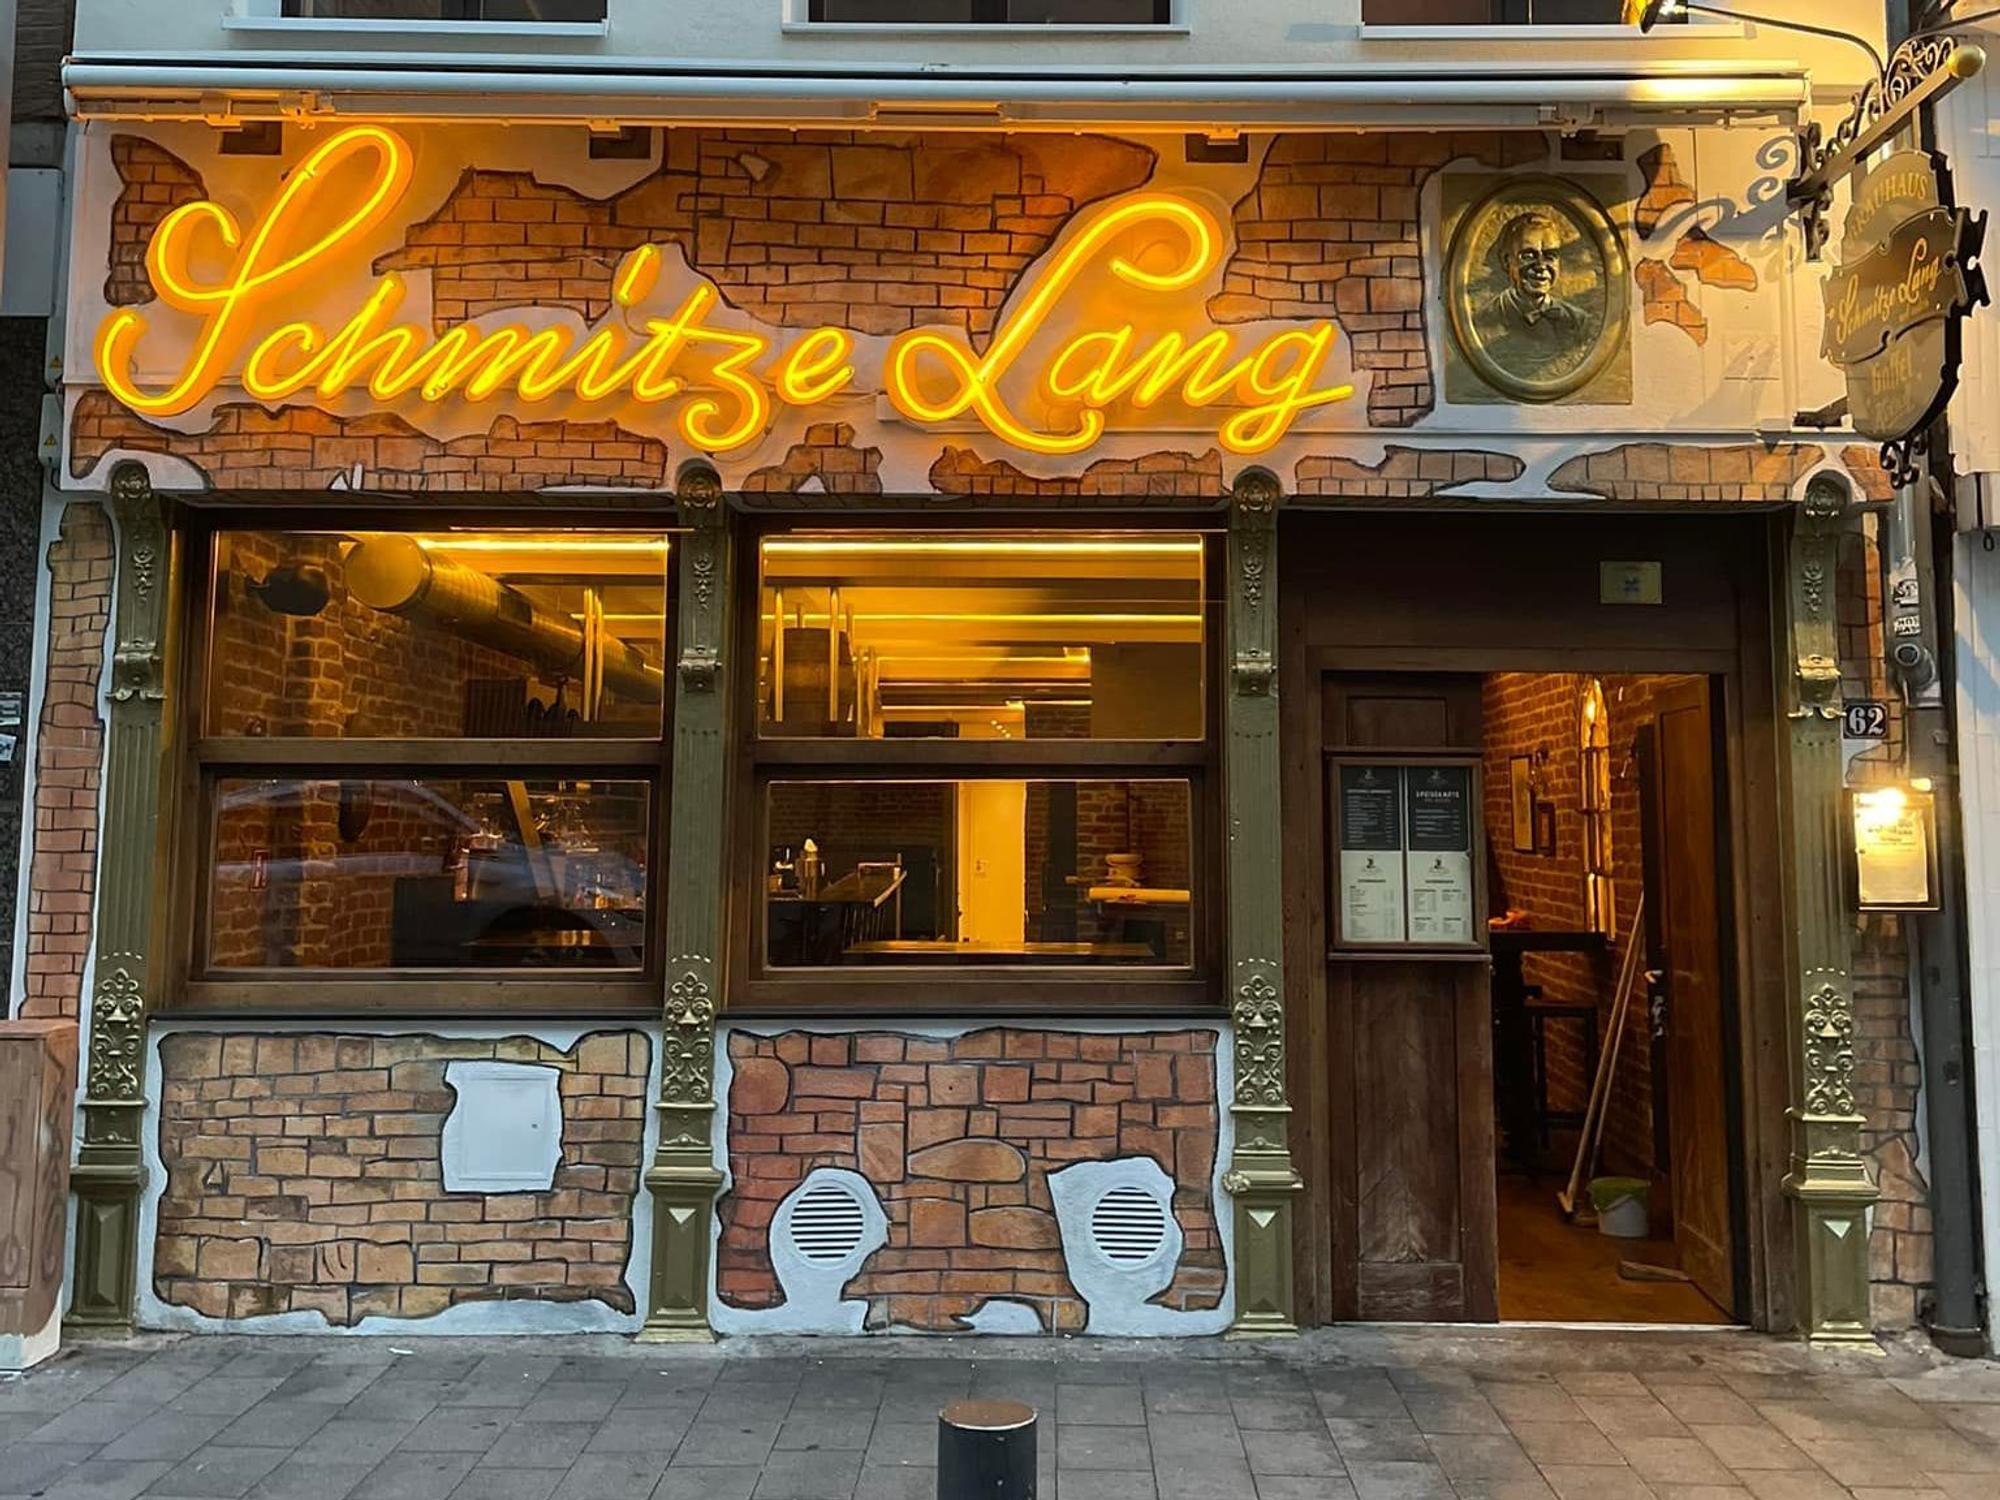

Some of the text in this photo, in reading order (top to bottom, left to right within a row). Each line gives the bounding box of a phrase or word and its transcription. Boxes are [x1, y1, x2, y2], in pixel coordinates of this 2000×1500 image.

[97, 125, 1354, 456] Schmitze Lang
[1898, 237, 1942, 304] Lang
[1848, 706, 1885, 736] 62
